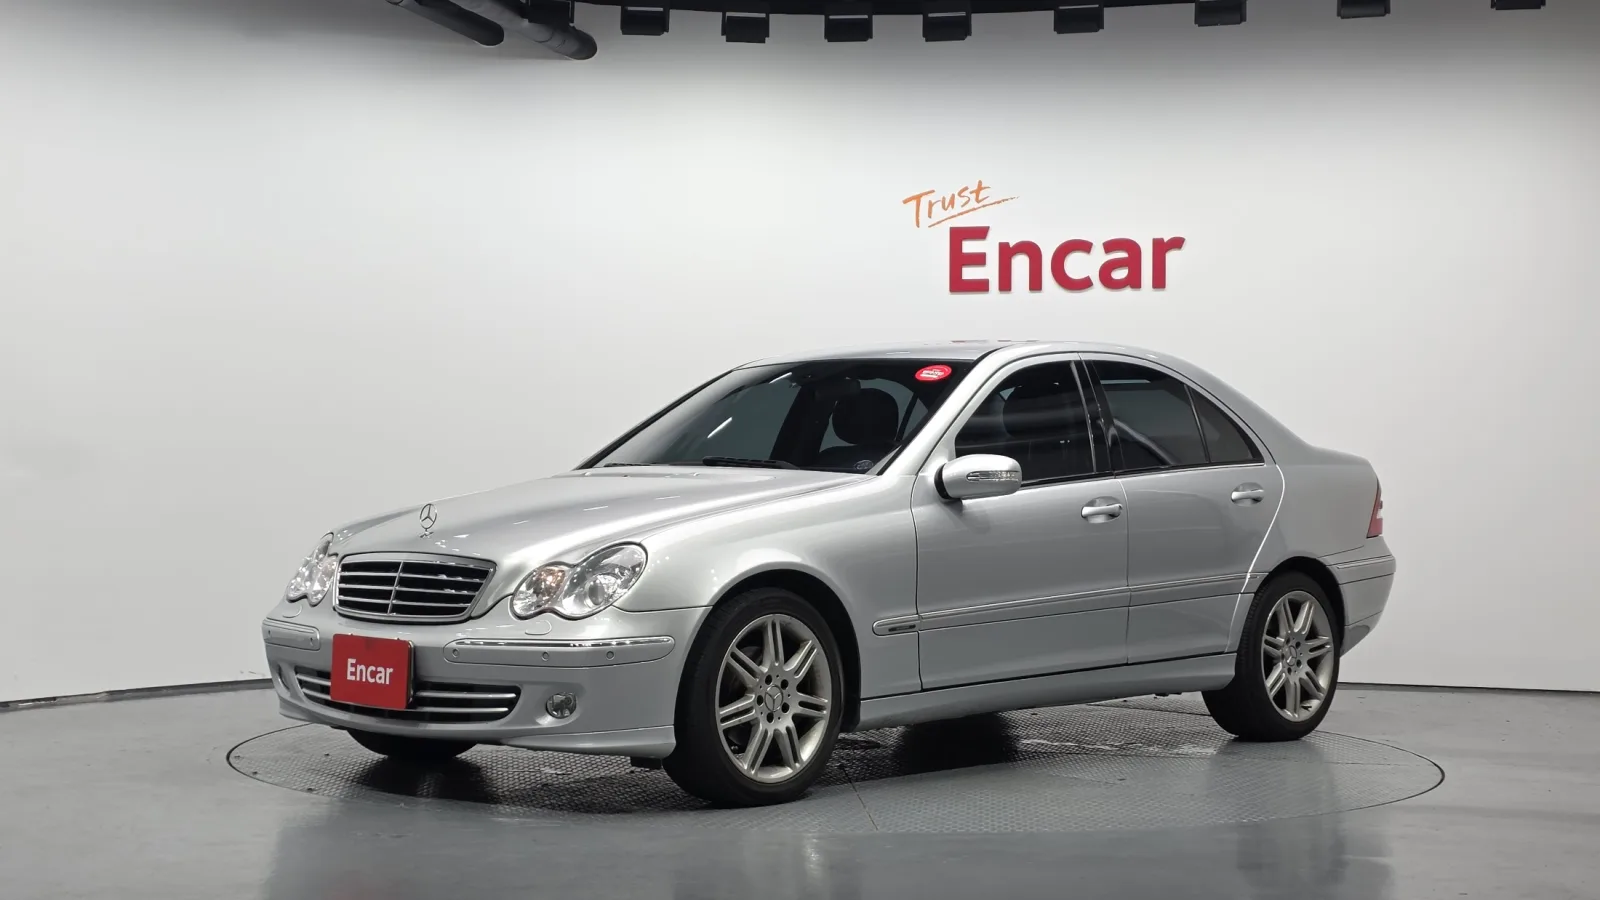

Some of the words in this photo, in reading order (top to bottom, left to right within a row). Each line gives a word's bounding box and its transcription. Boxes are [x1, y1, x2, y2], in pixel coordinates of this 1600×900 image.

[902, 180, 991, 228] Trust
[949, 226, 1186, 293] Encar
[346, 658, 394, 685] Encar
